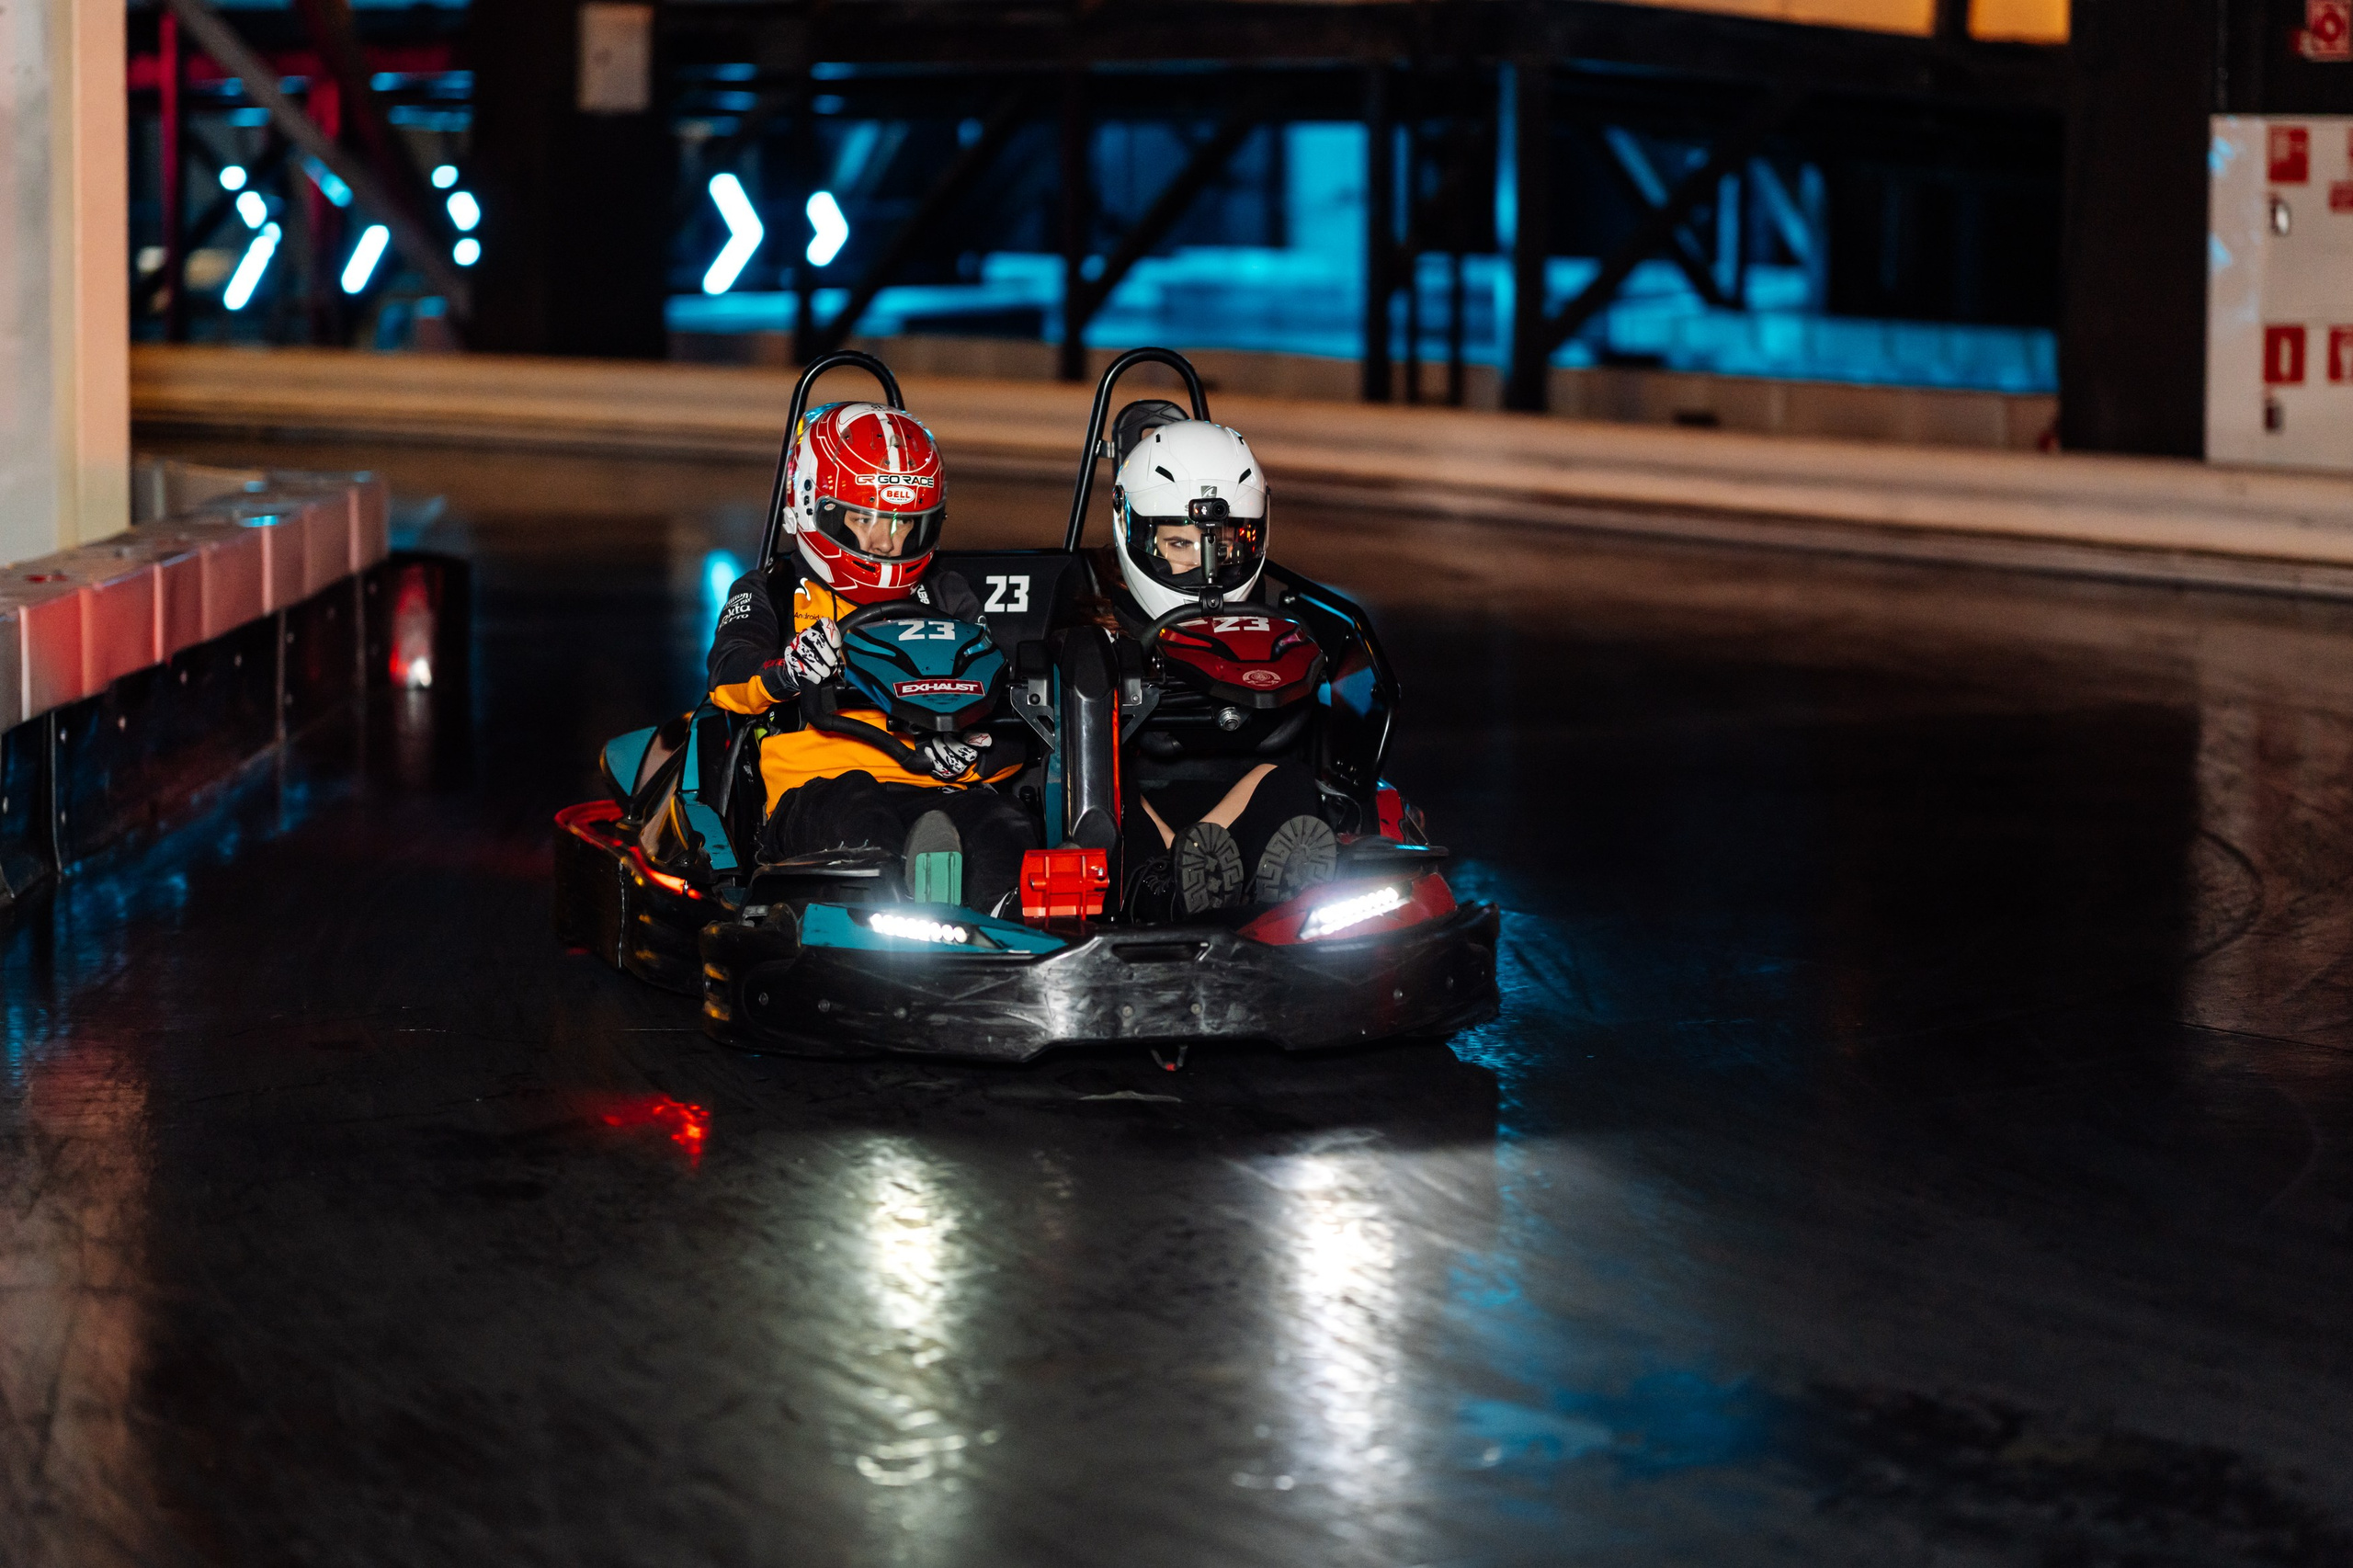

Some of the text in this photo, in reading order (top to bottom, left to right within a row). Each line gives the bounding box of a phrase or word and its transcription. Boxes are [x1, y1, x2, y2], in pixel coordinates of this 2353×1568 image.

[878, 475, 900, 484] GO
[902, 475, 934, 487] RACE
[886, 490, 911, 499] BELL
[984, 575, 1029, 612] 23
[794, 611, 820, 620] Android
[898, 620, 956, 641] 23
[1212, 616, 1270, 633] 23
[902, 684, 978, 693] EXHAUST
